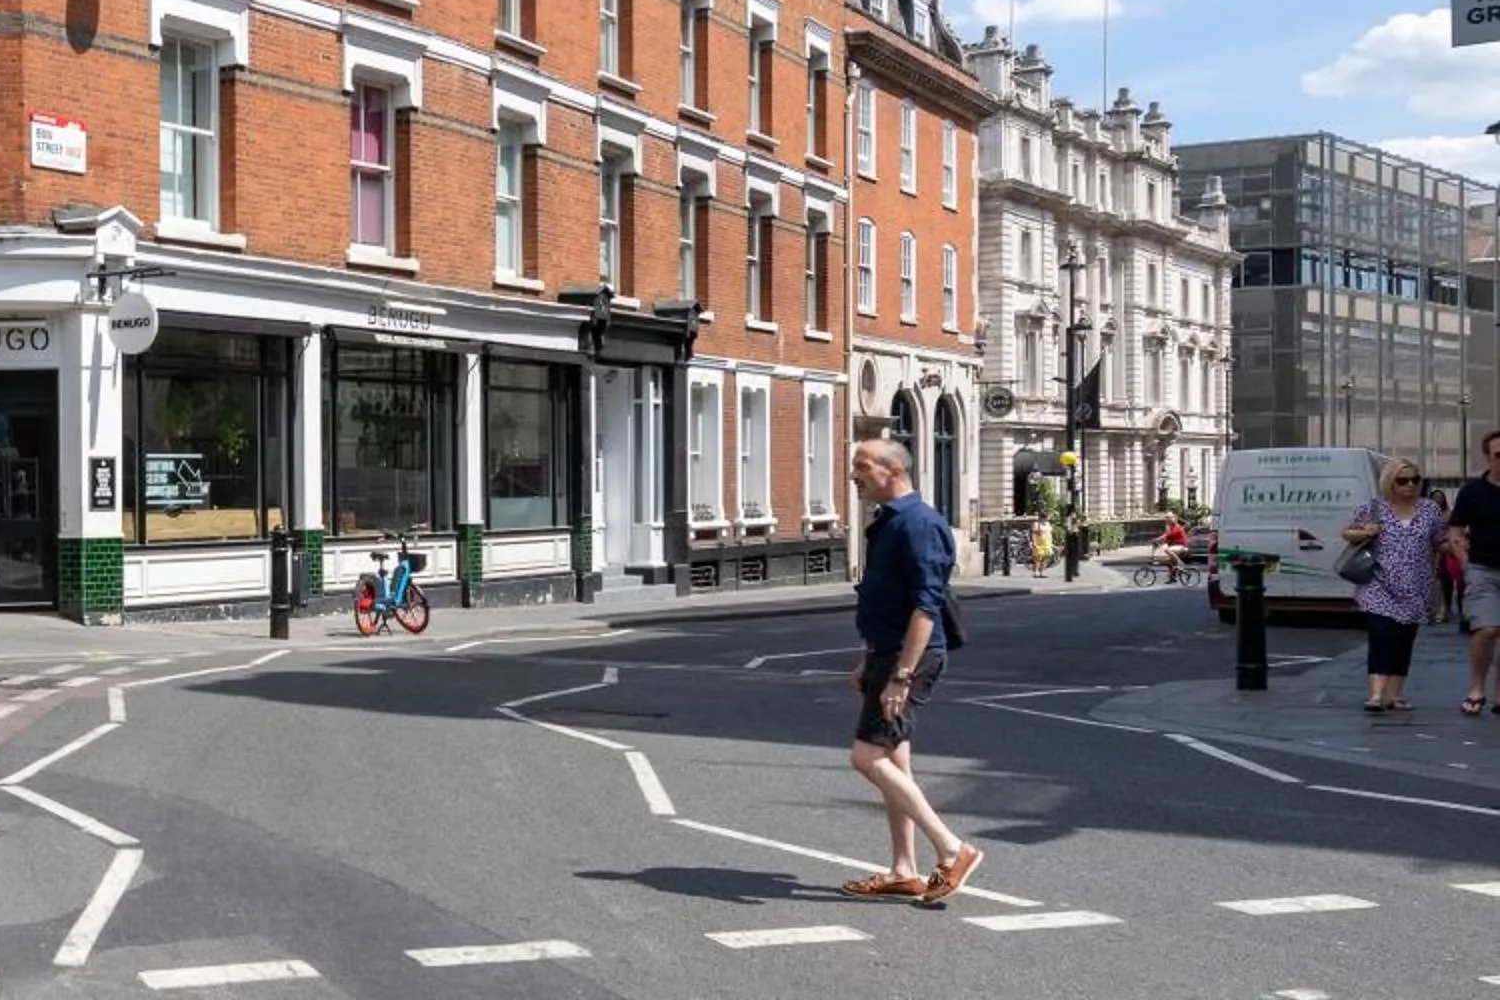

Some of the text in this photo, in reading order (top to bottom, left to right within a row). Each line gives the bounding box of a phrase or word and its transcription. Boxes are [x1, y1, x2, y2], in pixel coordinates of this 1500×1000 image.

[35, 141, 63, 156] STREET
[111, 317, 150, 330] BENUGO
[368, 305, 432, 331] BENUGO
